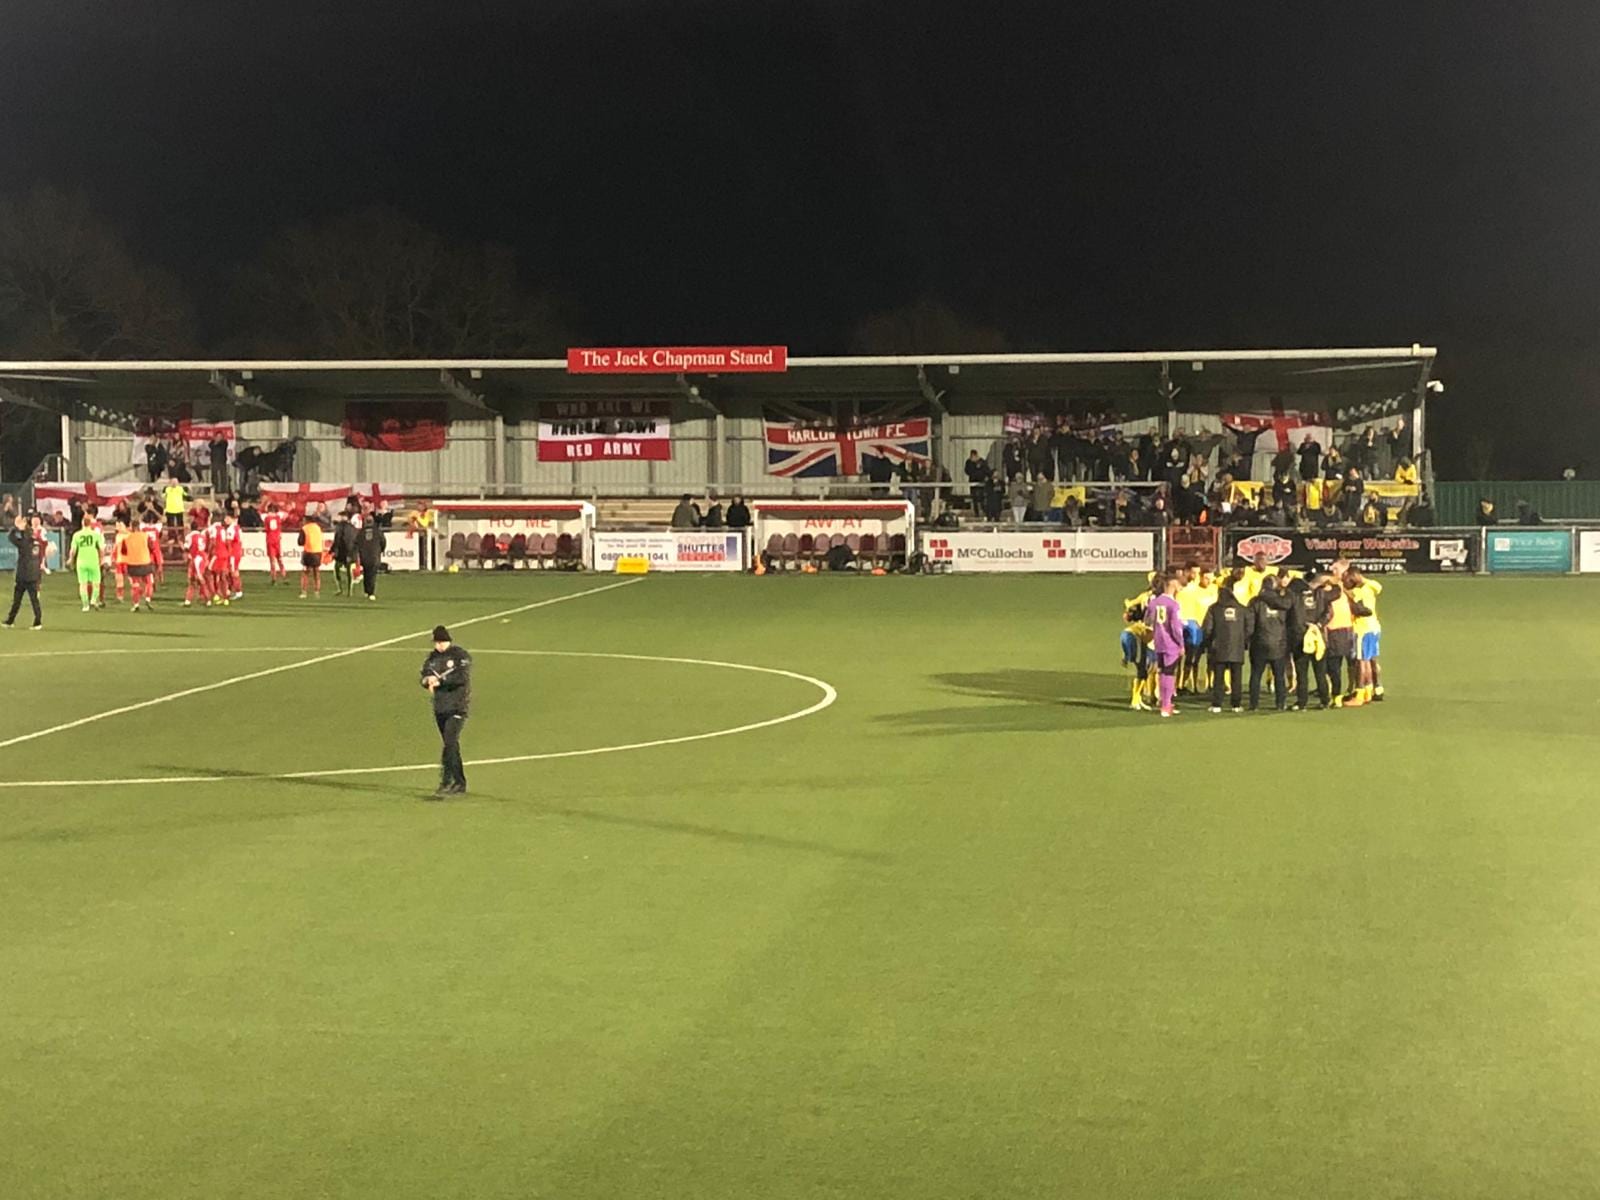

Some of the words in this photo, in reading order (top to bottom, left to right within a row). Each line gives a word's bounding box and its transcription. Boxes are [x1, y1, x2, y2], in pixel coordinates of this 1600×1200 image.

[580, 350, 610, 366] The
[614, 350, 648, 366] Jack
[652, 350, 725, 369] Chapman
[730, 349, 773, 365] Stand
[566, 443, 593, 457] RED
[603, 442, 641, 456] ARMY
[79, 535, 93, 547] 20
[677, 543, 725, 553] SHUTTER
[957, 547, 1034, 558] McCullochs
[1070, 547, 1148, 558] McCullochs
